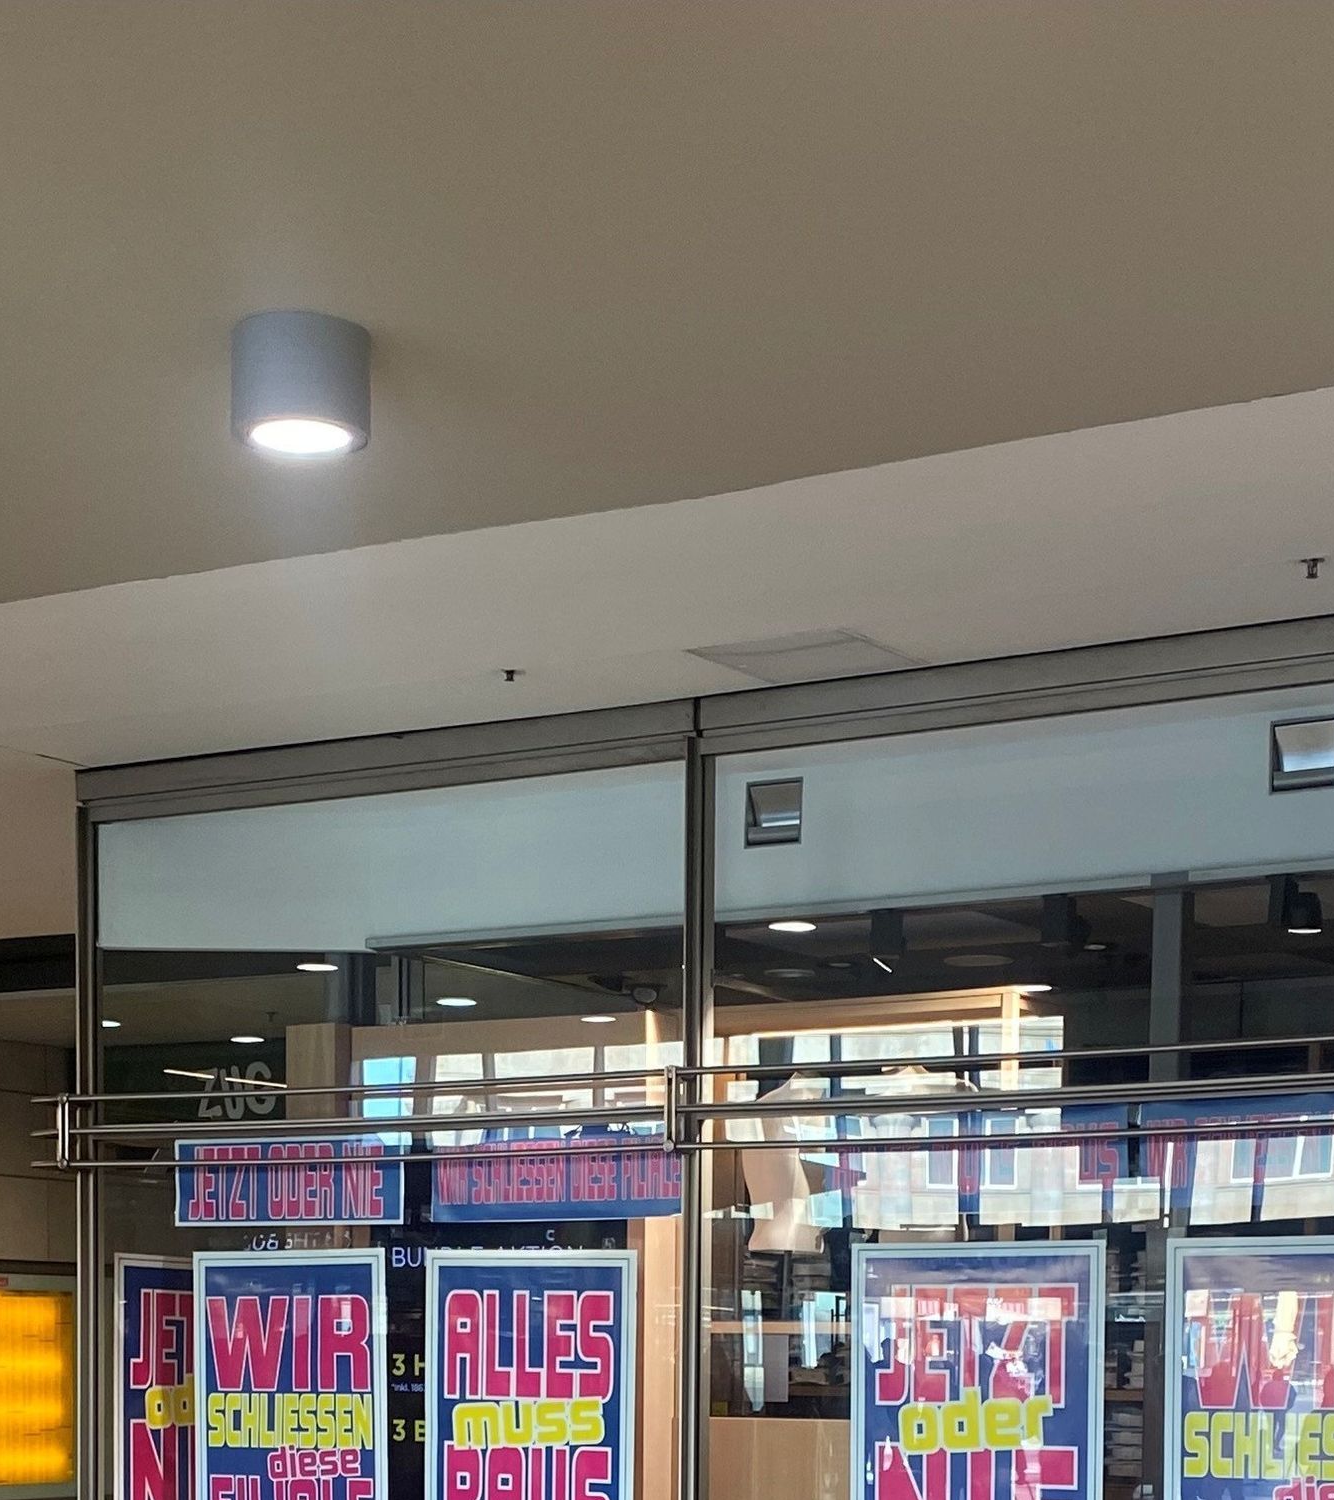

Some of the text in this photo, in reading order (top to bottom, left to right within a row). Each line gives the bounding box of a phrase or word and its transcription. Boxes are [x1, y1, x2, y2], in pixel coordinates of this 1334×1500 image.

[188, 1141, 385, 1221] JETZT ODER NIE
[129, 1288, 195, 1392] JET
[207, 1295, 371, 1392] WIR
[392, 1354, 405, 1376] 3
[443, 1289, 614, 1403] ALLES
[874, 1282, 1079, 1409] JETZT
[145, 1373, 196, 1430] od
[208, 1392, 373, 1450] SCHLIESSEN
[452, 1399, 605, 1450] muss
[899, 1387, 1053, 1455] oder
[267, 1443, 361, 1480] diese
